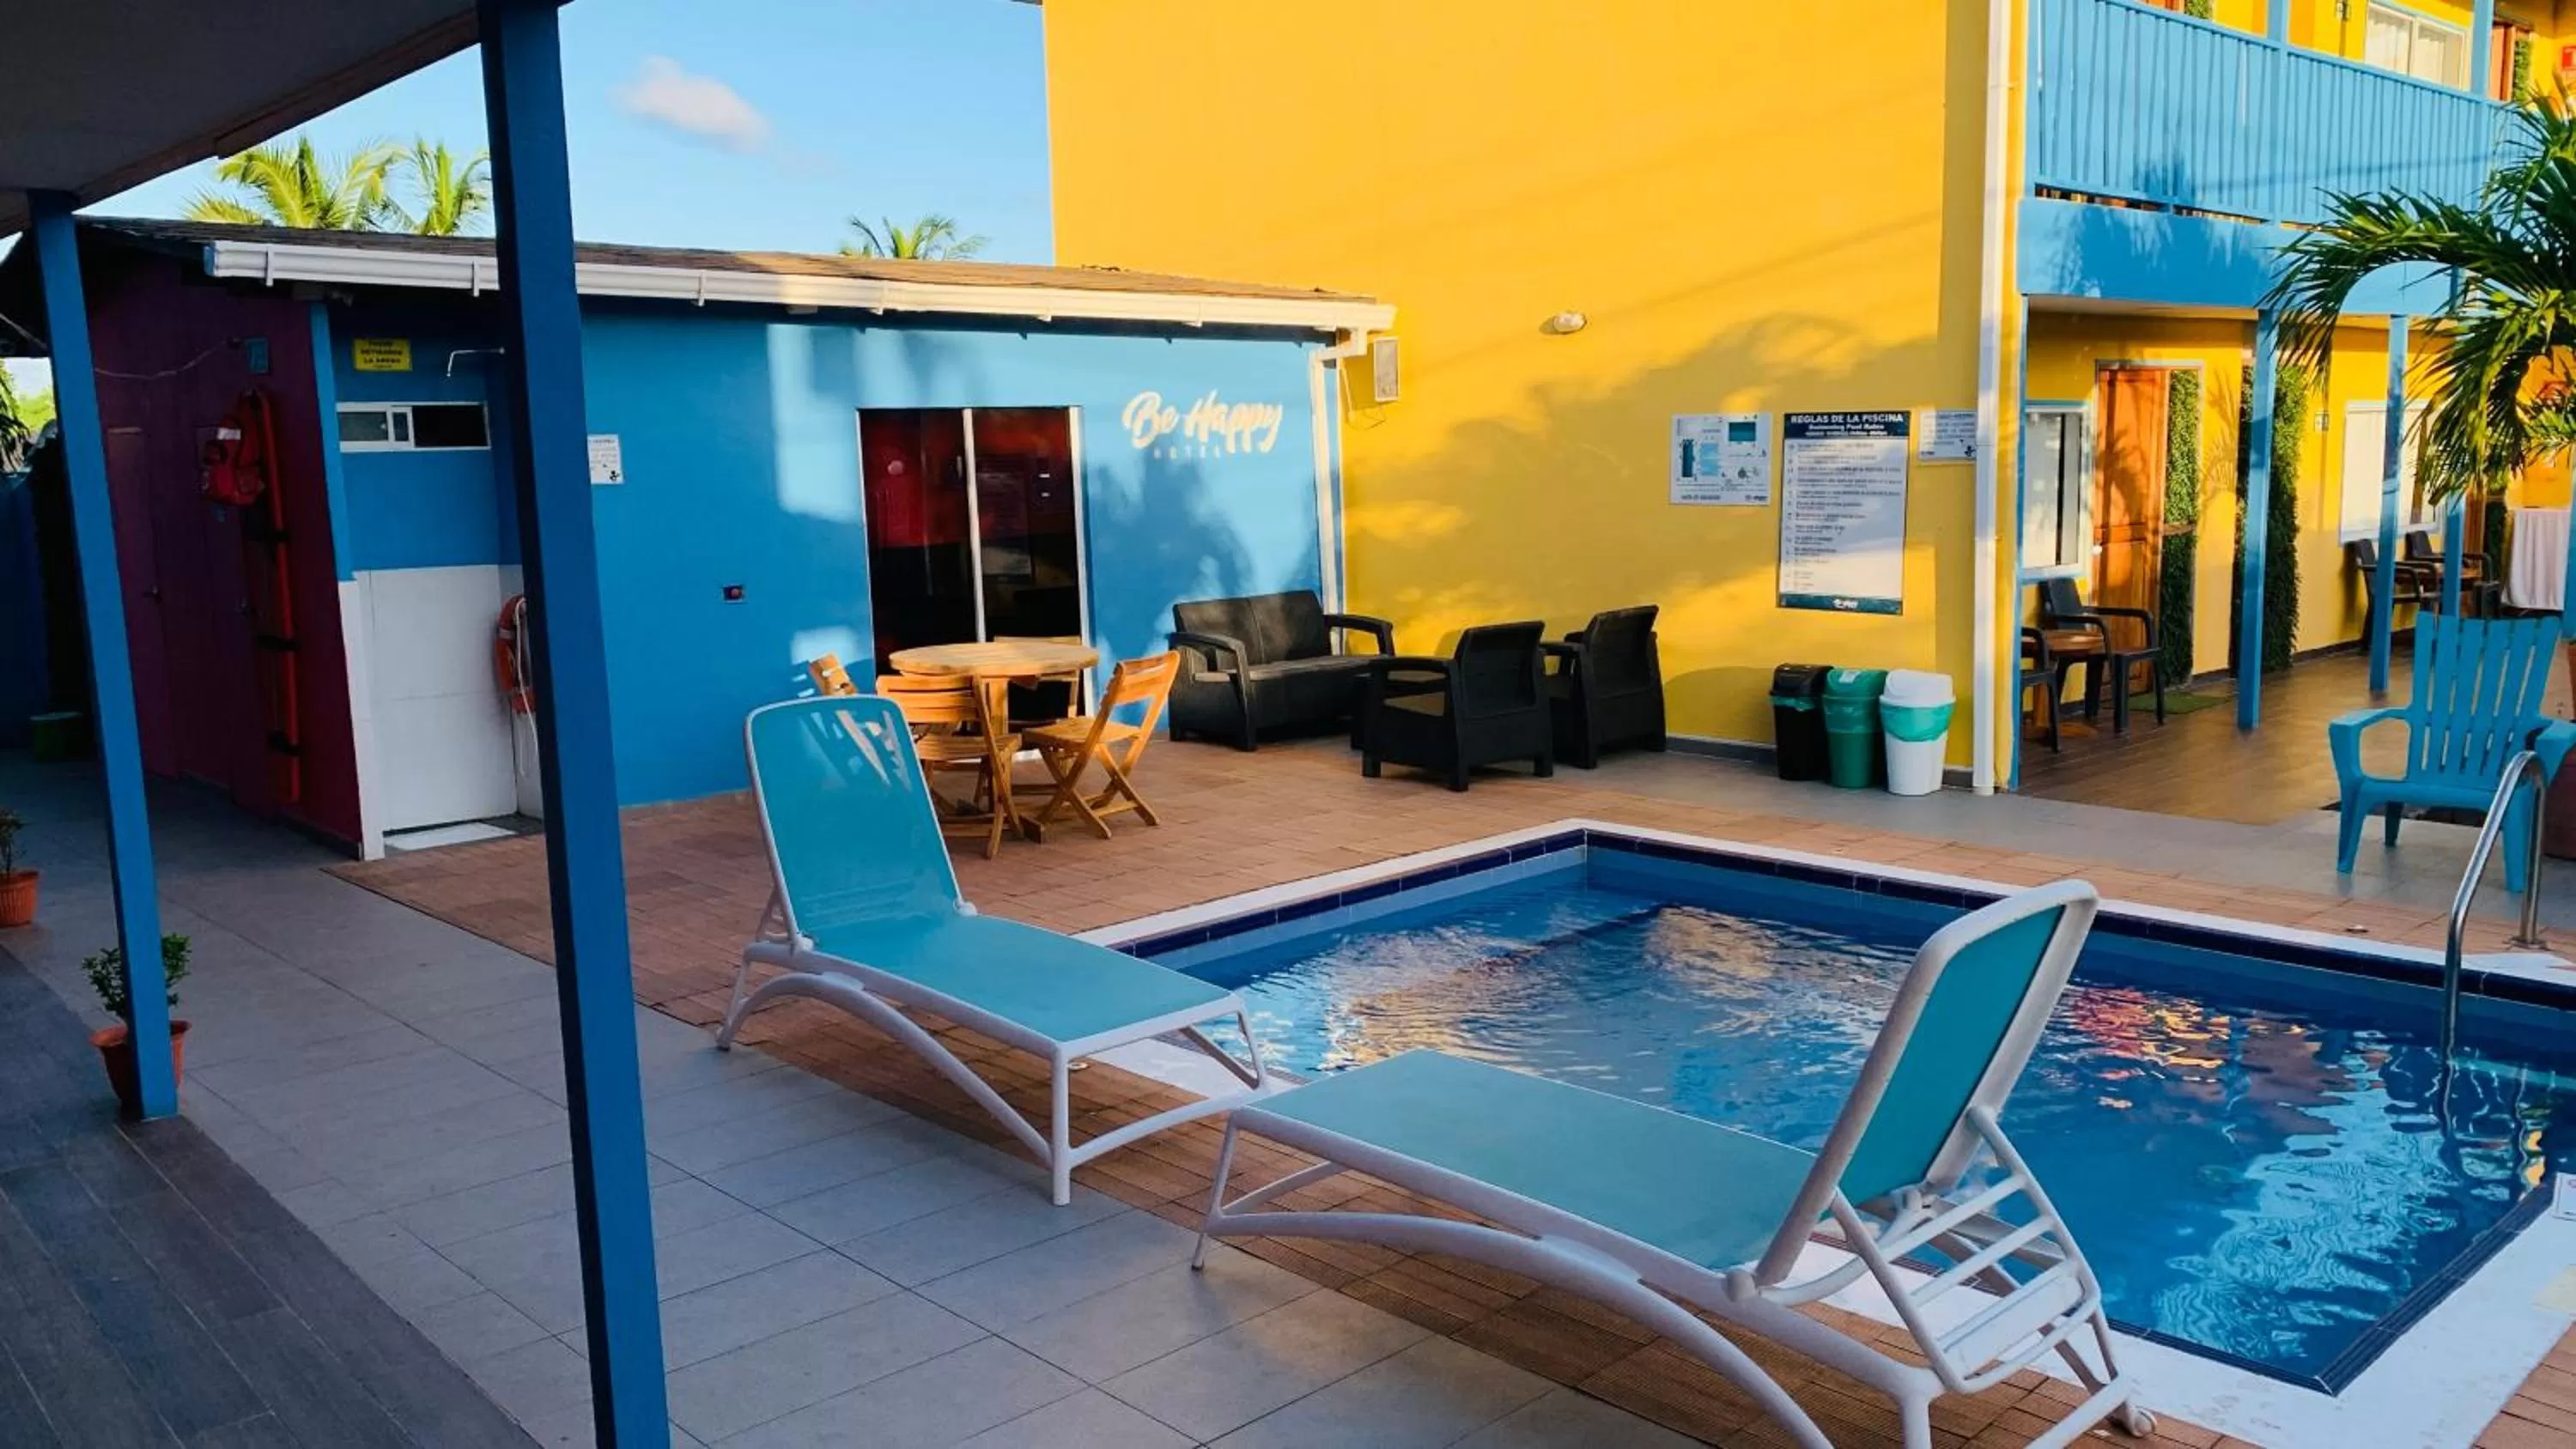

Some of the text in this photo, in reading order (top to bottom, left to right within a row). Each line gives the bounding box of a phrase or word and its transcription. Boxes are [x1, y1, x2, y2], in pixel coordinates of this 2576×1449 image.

[1121, 388, 1284, 454] Be Happy
[1790, 413, 1904, 424] REGLAS DE LA PISCINA
